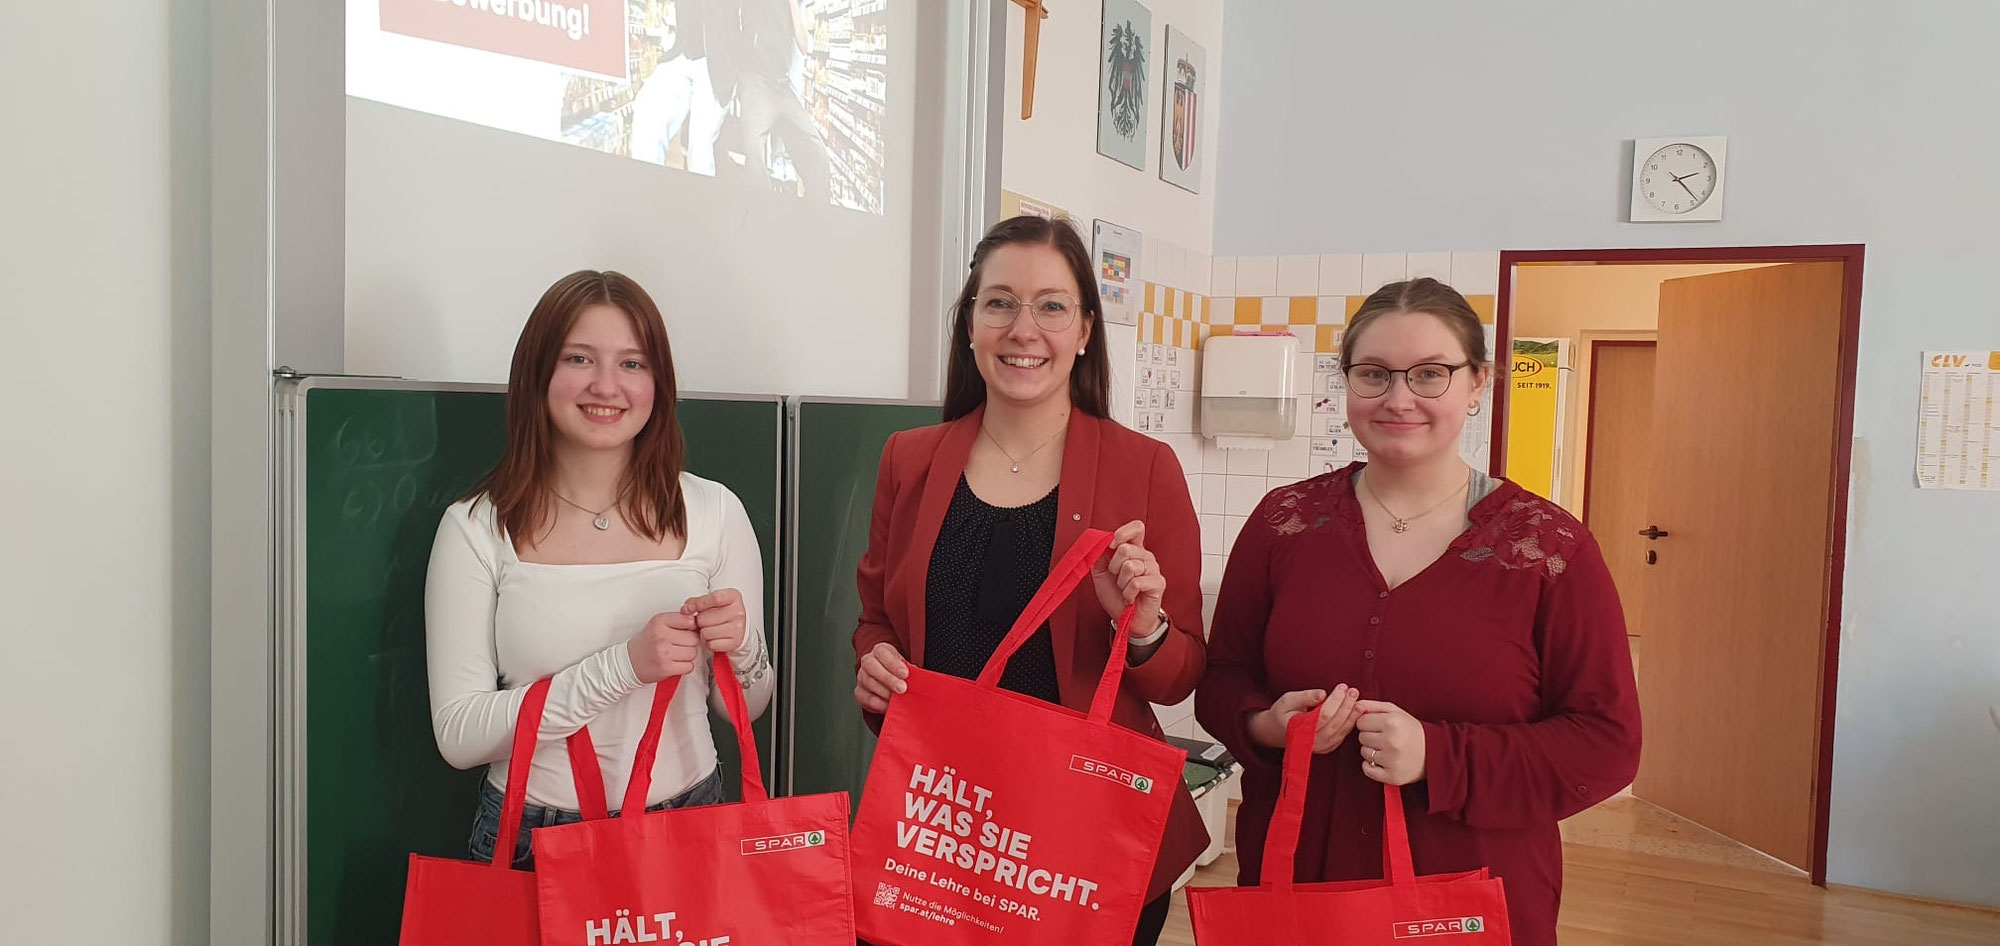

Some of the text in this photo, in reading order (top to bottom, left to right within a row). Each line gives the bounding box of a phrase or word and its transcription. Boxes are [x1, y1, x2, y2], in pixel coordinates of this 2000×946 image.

[1931, 355, 1966, 368] CLV
[1083, 761, 1132, 784] SPAR
[909, 764, 993, 820] HÄLT,
[905, 791, 1032, 860] WAS SIE
[755, 835, 805, 851] SPAR
[896, 820, 1100, 911] VERSPRICHT.
[884, 858, 1041, 921] Deine Lehre bei SPAR.
[902, 891, 927, 907] Nutze
[929, 901, 942, 912] die
[899, 902, 955, 926] spar.at/lehre
[586, 909, 684, 946] HÄLT,
[1408, 922, 1461, 934] SPAR
